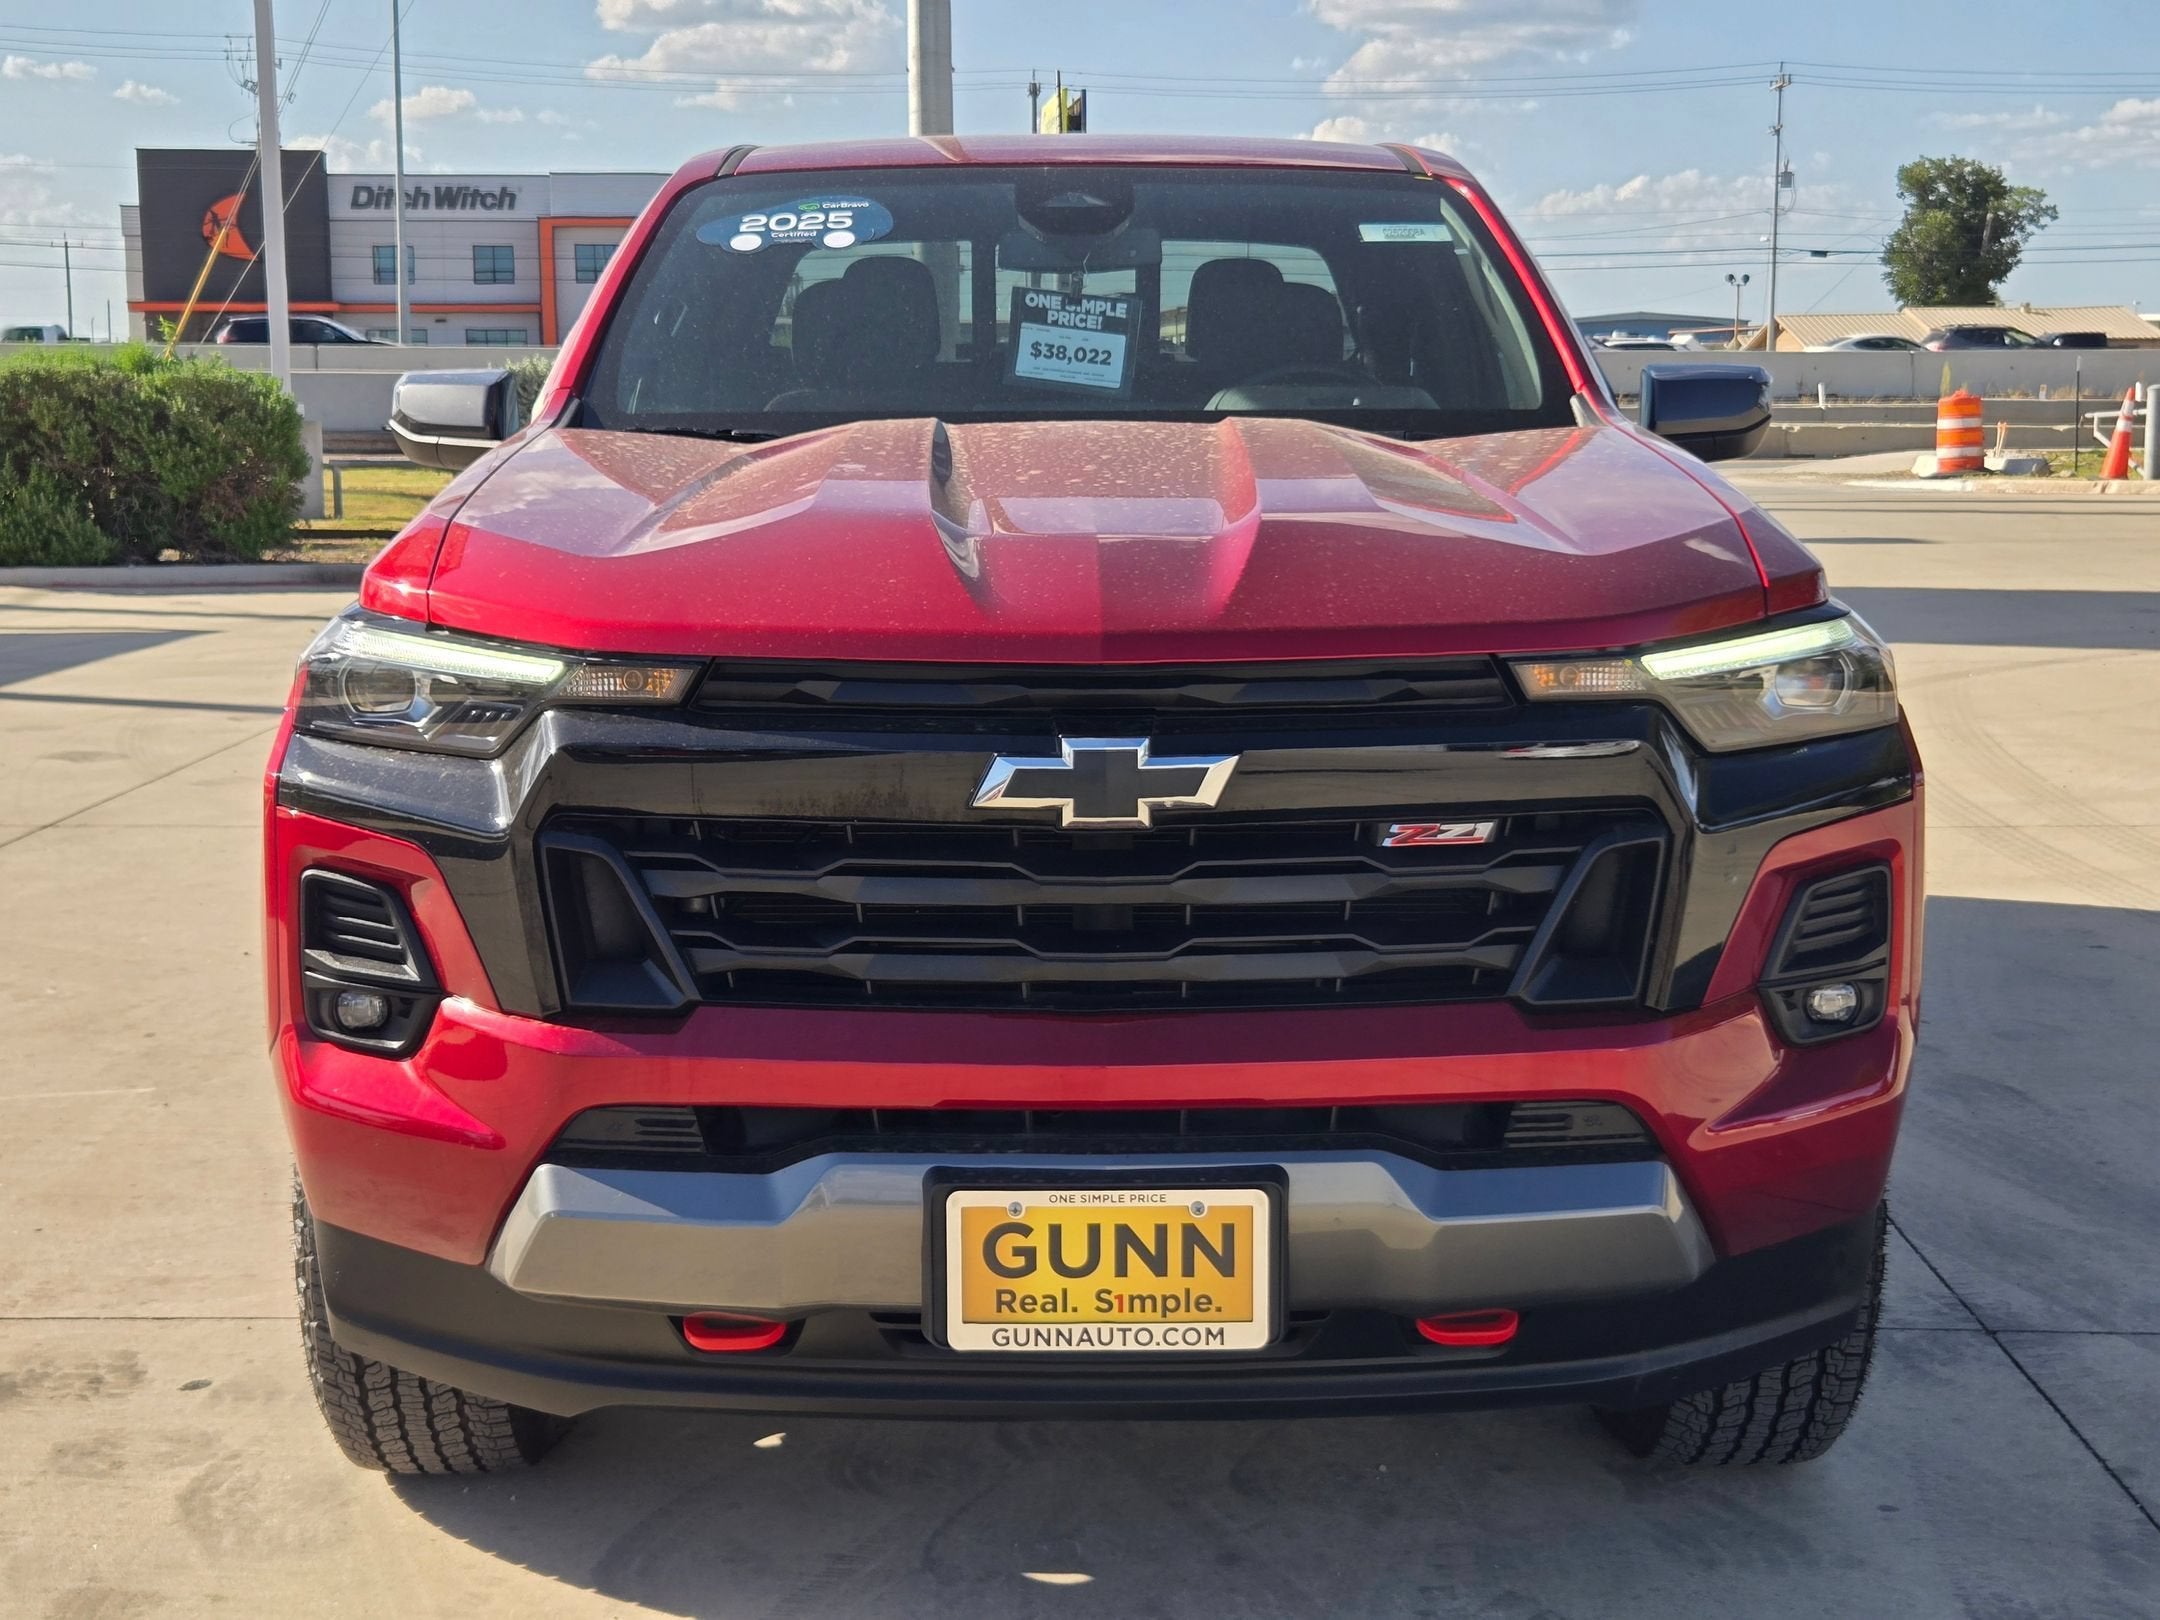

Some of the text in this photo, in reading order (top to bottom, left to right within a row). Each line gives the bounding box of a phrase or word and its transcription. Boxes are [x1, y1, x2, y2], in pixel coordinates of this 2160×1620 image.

[434, 186, 517, 210] Witch
[739, 211, 853, 232] 2025
[771, 230, 817, 238] Certified
[1025, 293, 1062, 310] ONE
[1047, 310, 1103, 330] PRICE!
[1030, 341, 1112, 366] $38,022
[1382, 822, 1494, 847] Z71
[1049, 1193, 1167, 1204] ONE SIMPLE PRICE
[982, 1221, 1235, 1279] GUNN
[995, 1288, 1078, 1314] Real.
[992, 1327, 1225, 1347] GUNNAUTO.COM
